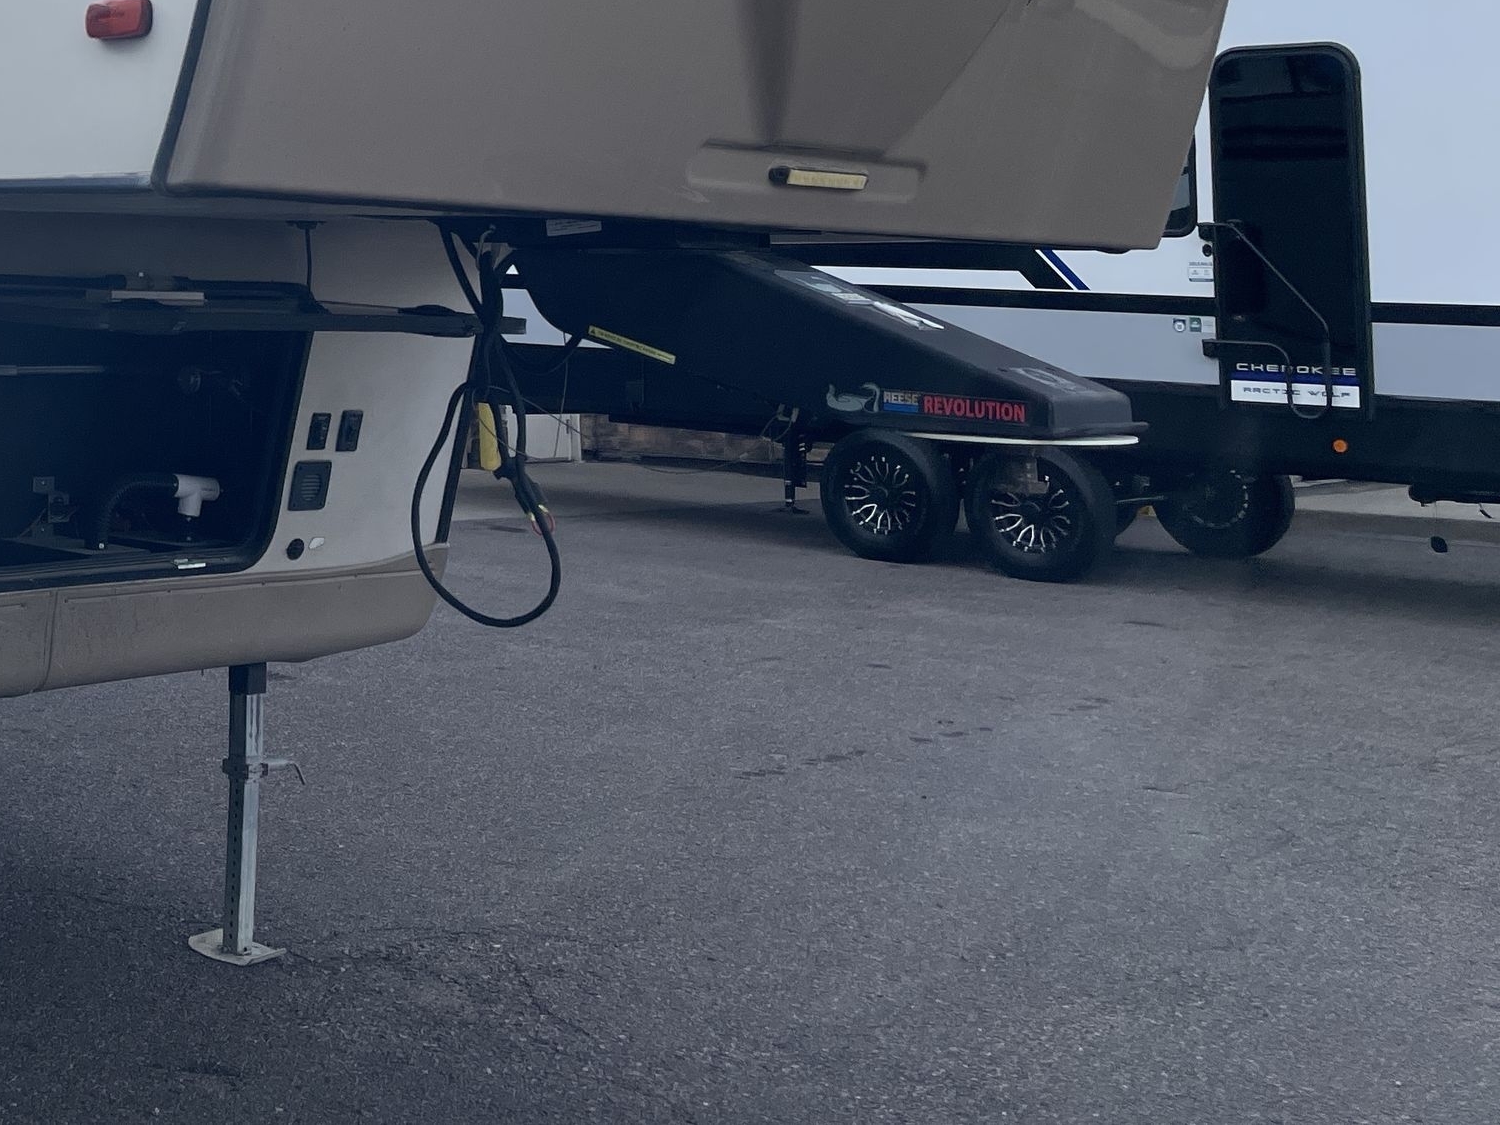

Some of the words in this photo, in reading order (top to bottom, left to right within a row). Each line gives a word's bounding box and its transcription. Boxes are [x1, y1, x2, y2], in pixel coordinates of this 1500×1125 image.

[1243, 386, 1301, 397] ARCTC
[883, 390, 919, 405] REESE
[923, 394, 1026, 423] REVOLUTION
